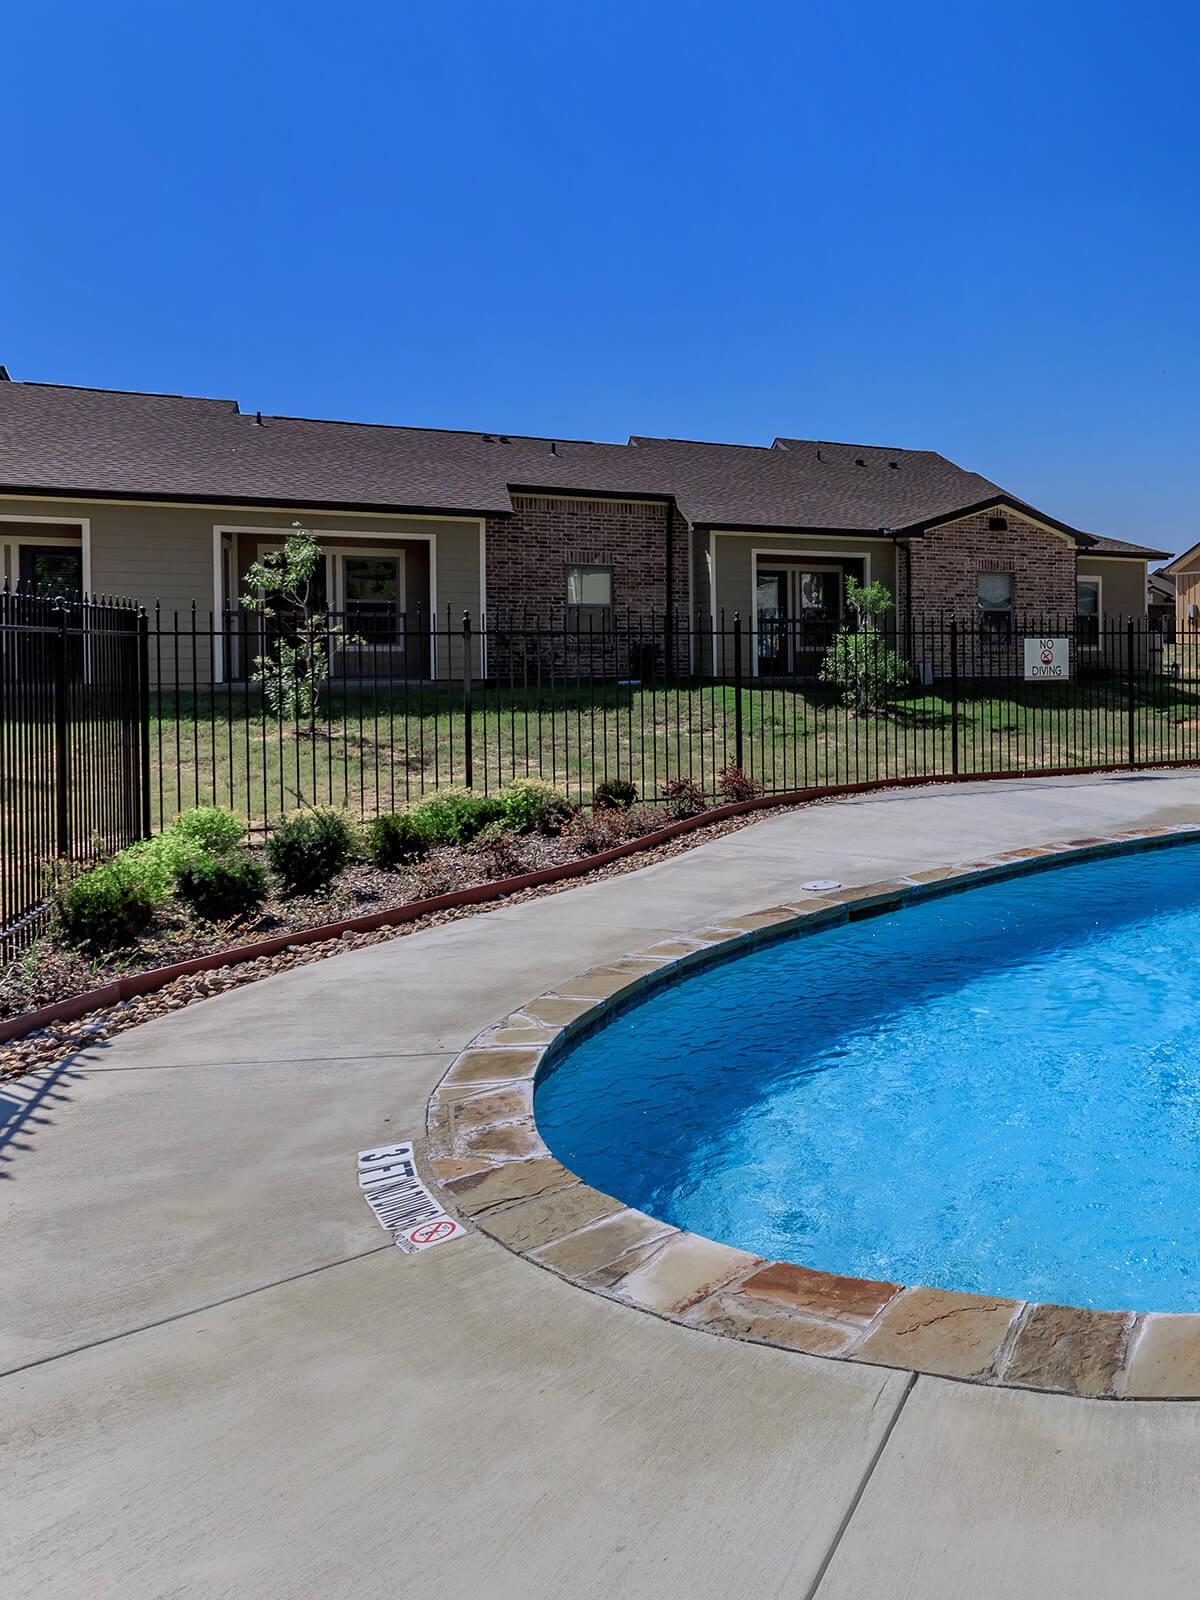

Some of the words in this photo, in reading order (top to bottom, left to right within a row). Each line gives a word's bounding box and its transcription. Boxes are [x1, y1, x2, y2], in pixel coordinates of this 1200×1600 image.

[1040, 640, 1054, 649] NO
[1032, 666, 1062, 675] DIVING
[360, 1148, 409, 1162] 3
[360, 1161, 414, 1185] FT
[367, 1178, 420, 1201] NO
[373, 1190, 439, 1228] DIVING
